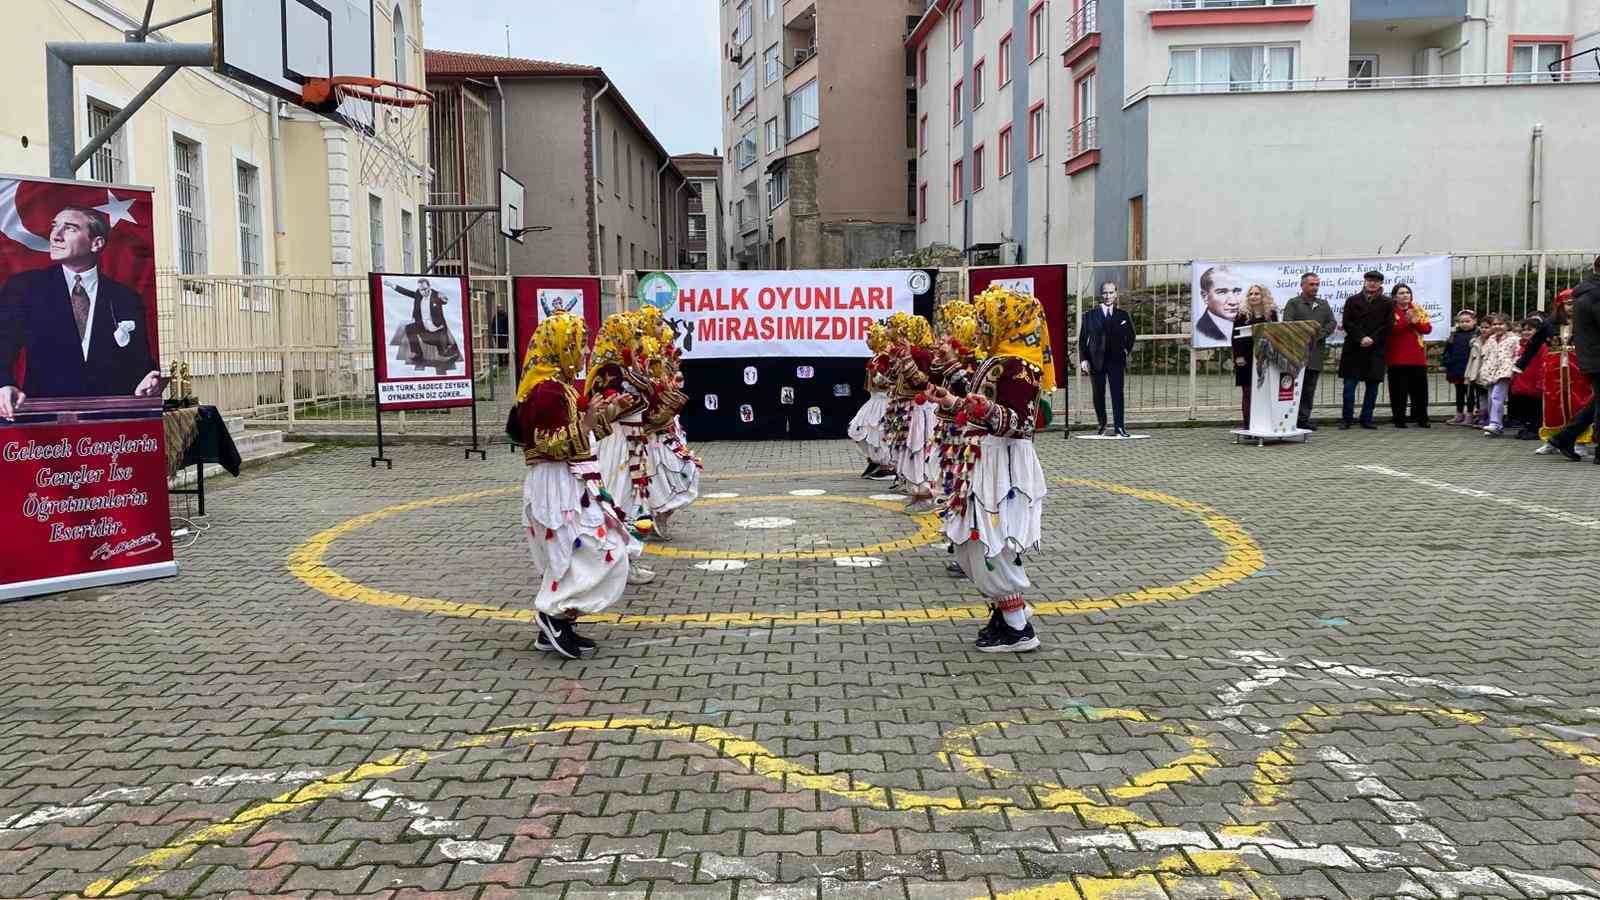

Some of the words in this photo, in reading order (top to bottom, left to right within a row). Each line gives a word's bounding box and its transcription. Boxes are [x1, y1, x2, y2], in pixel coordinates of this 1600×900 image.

[679, 287, 748, 312] HALK
[758, 286, 893, 311] OYUNLARI
[3, 438, 72, 462] Gelecek
[77, 434, 158, 461] Gençlerin
[36, 464, 104, 489] Gençler
[108, 459, 133, 482] İse
[23, 488, 148, 522] Öğretmenlerin
[49, 517, 127, 543] Eseridir.
